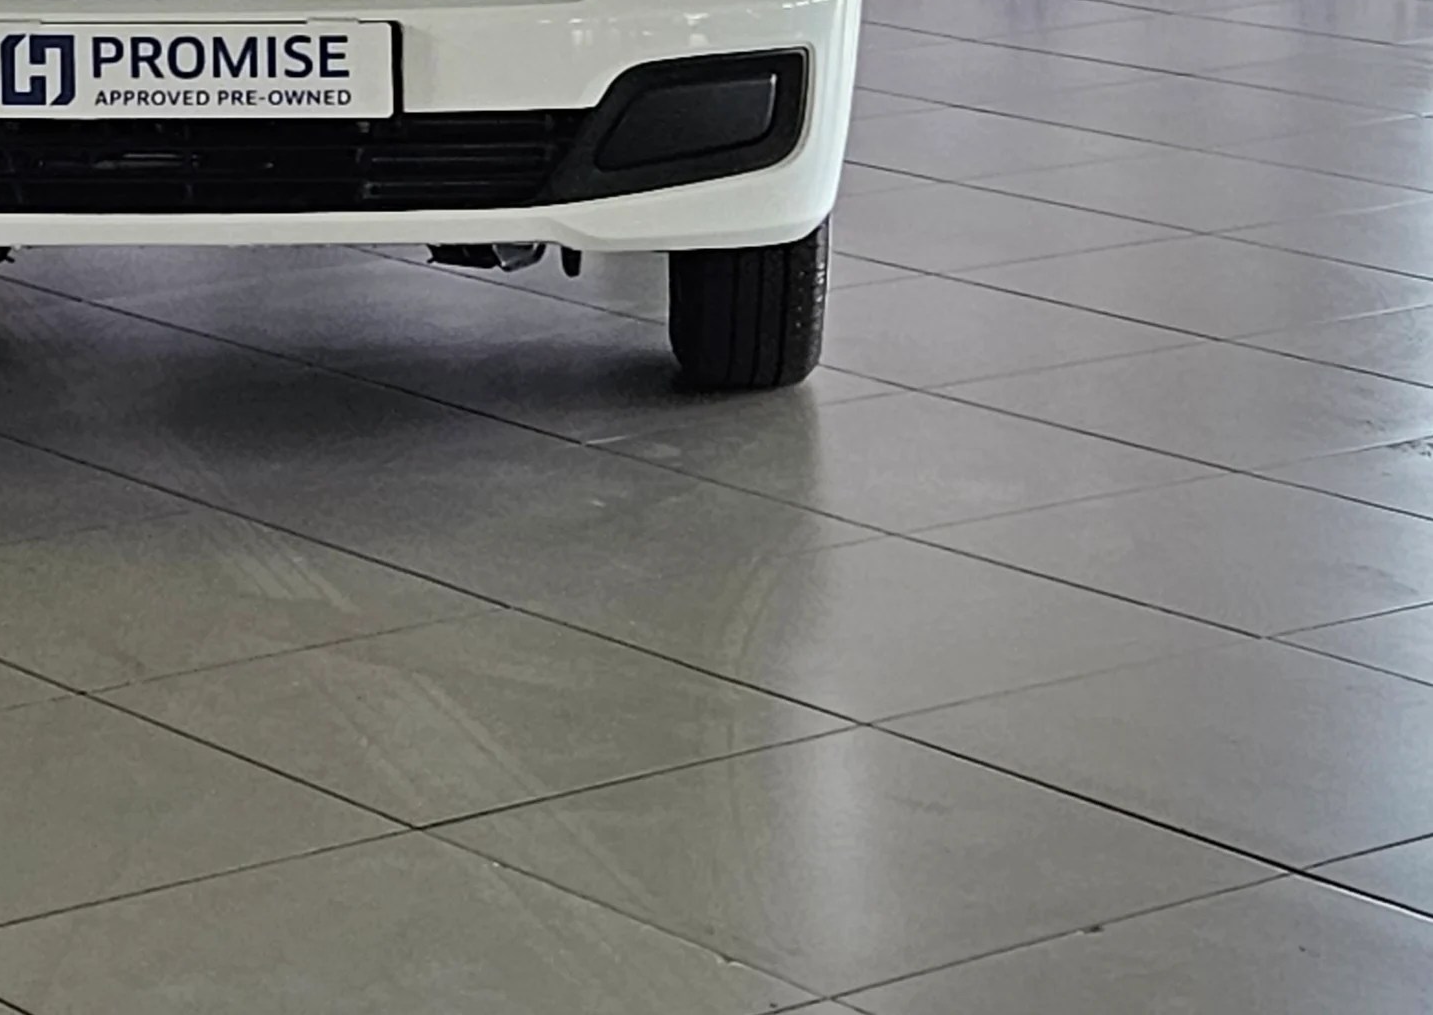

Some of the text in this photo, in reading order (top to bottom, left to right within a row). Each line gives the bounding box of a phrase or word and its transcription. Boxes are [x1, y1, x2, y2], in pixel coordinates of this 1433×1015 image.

[91, 34, 350, 80] PROMISE
[94, 89, 352, 106] APPROVED PRE-OWNED
